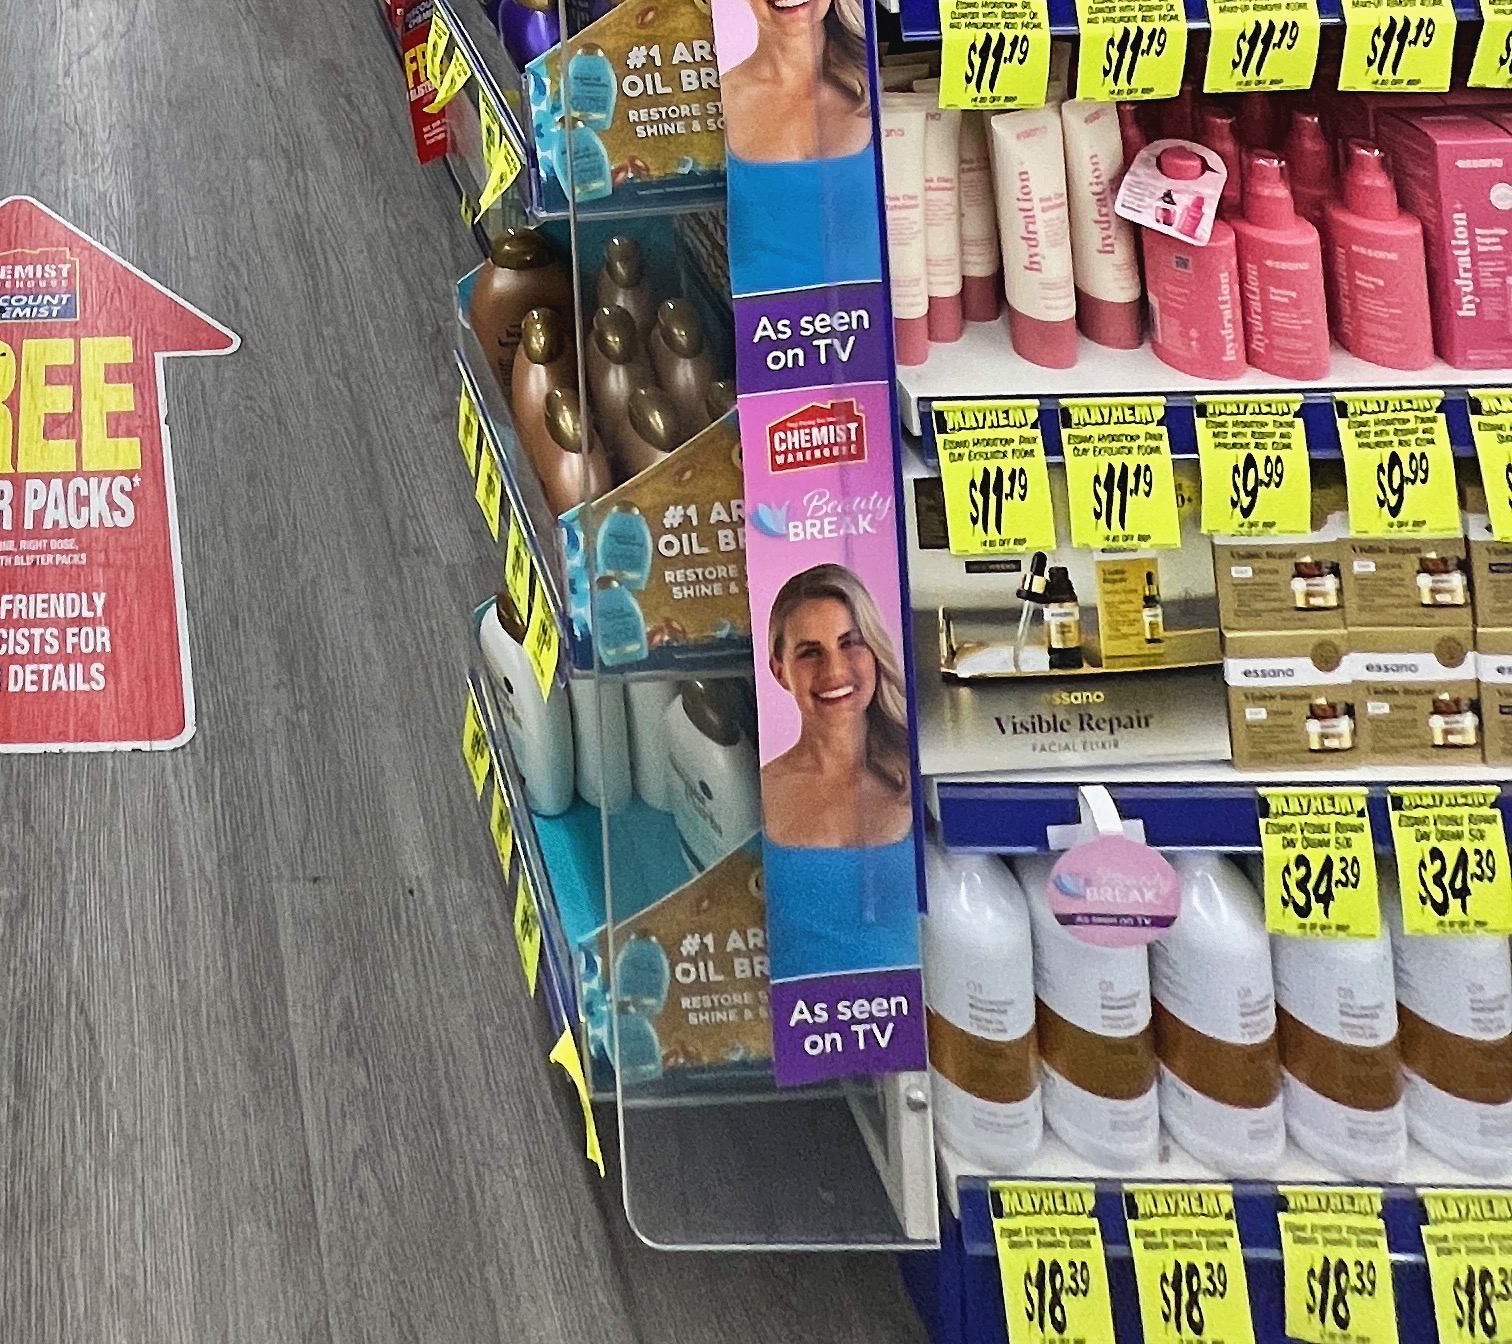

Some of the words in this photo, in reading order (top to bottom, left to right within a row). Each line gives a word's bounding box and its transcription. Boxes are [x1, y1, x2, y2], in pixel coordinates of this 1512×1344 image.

[20, 539, 49, 551] RIGHT
[0, 592, 106, 618] FRIENDLY
[66, 626, 111, 654] FOR
[8, 663, 106, 692] DETAILS
[1243, 666, 1294, 679] essano
[994, 714, 1071, 736] Visible
[1077, 712, 1152, 735] Repair
